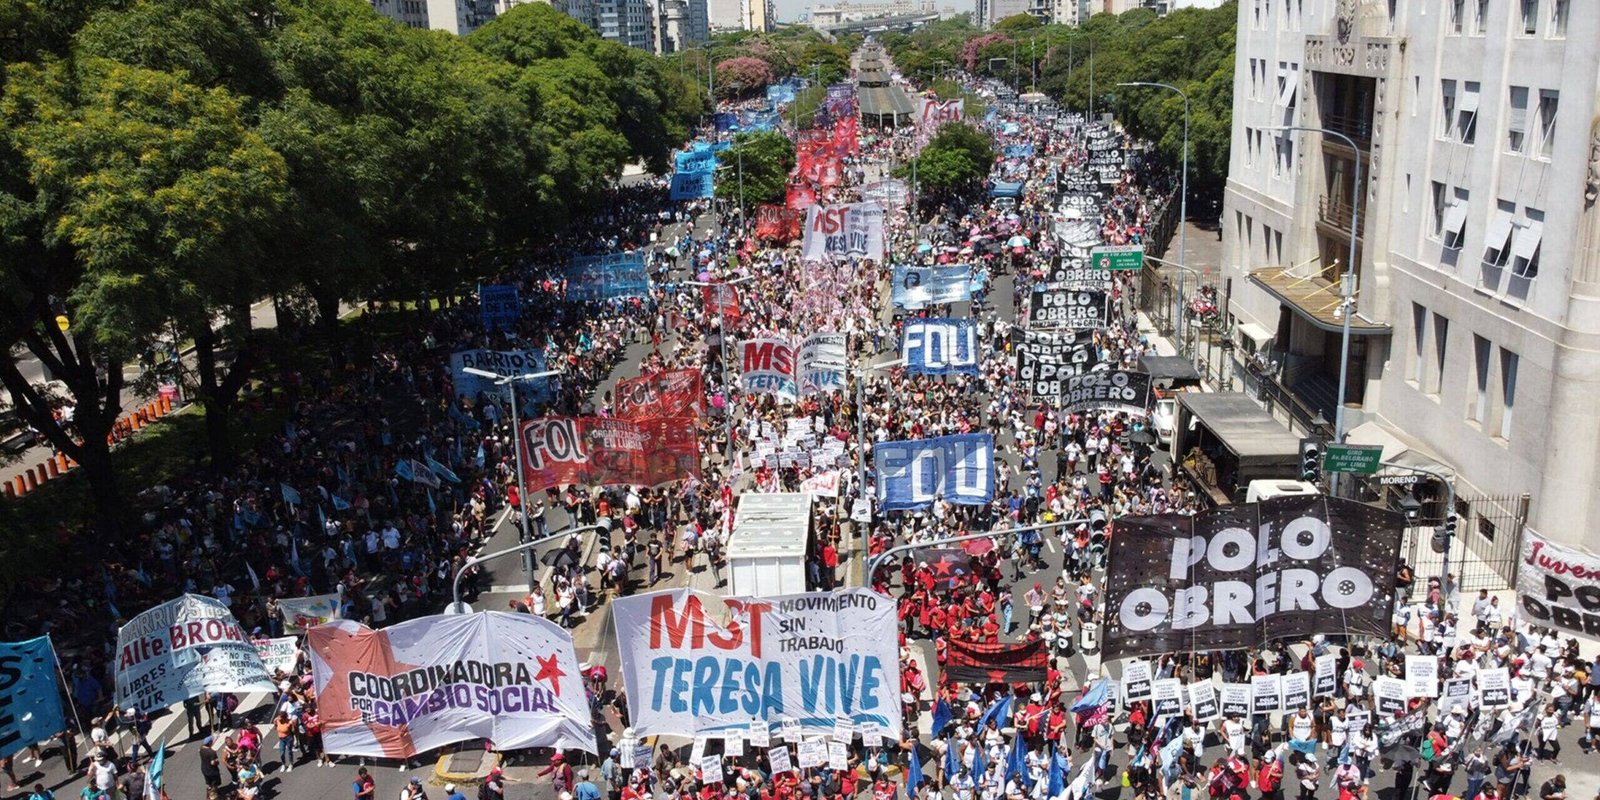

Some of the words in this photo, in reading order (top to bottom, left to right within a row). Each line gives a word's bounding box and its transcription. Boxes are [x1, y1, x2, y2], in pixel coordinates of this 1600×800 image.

[1062, 196, 1094, 205] POLO
[1055, 270, 1111, 281] OBRERO
[1042, 293, 1091, 307] POLO
[1036, 306, 1098, 320] OBRERO
[901, 324, 976, 368] FDU
[1025, 331, 1076, 344] POLO
[463, 352, 537, 368] BARRIOS
[1069, 372, 1129, 391] POLO
[620, 381, 659, 411] FOL
[1062, 386, 1136, 406] OBRERO
[601, 420, 632, 430] FRENTE
[524, 418, 588, 470] FOL
[604, 438, 616, 448] EN
[878, 441, 988, 502] FDU
[1381, 476, 1418, 484] MORENO
[1169, 516, 1331, 580] POLO
[1119, 566, 1374, 631] OBRERO
[649, 594, 773, 659] MST
[779, 594, 877, 614] MOVIMIENTO
[779, 617, 806, 633] SIN
[779, 636, 844, 654] TRABAJO
[121, 638, 167, 671] Alte.
[229, 652, 239, 660] NO
[243, 653, 251, 661] SE
[123, 662, 166, 698] LIBRES
[349, 660, 532, 701] COORDINADORA
[651, 656, 784, 720] TERESA
[799, 654, 882, 715] VIVE
[137, 683, 158, 698] DEL
[351, 697, 373, 712] POR
[373, 684, 472, 728] CAMBIO
[476, 684, 561, 715] SOCIAL
[361, 711, 374, 723] EL
